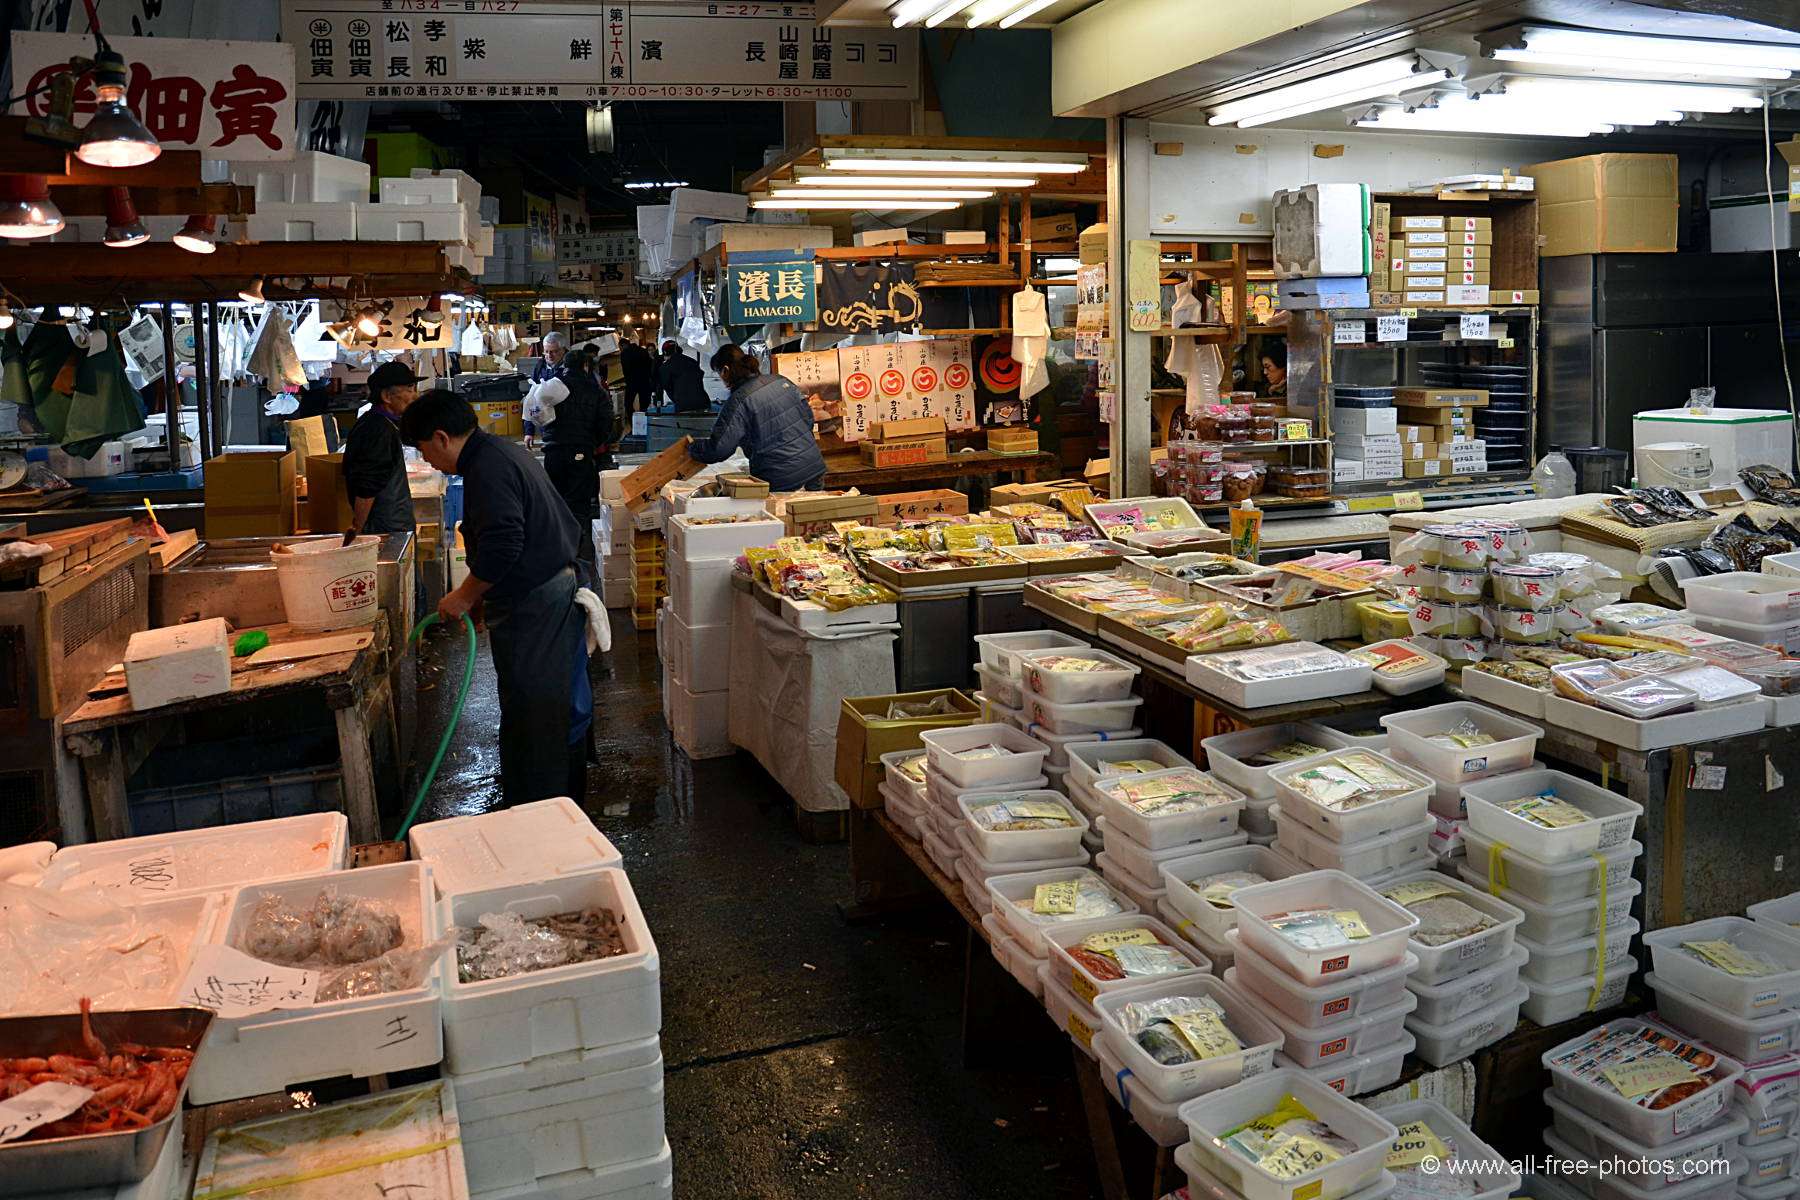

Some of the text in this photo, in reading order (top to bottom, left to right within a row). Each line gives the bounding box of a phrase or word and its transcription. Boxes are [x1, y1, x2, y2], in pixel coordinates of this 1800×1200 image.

[462, 38, 592, 61] 紫 鮮
[609, 8, 624, 79] 第七十八棟
[745, 41, 766, 62] 長
[737, 269, 806, 303] 濱長
[743, 305, 803, 318] HAMACHO
[1416, 606, 1432, 622] 品
[1392, 1140, 1426, 1152] 600
